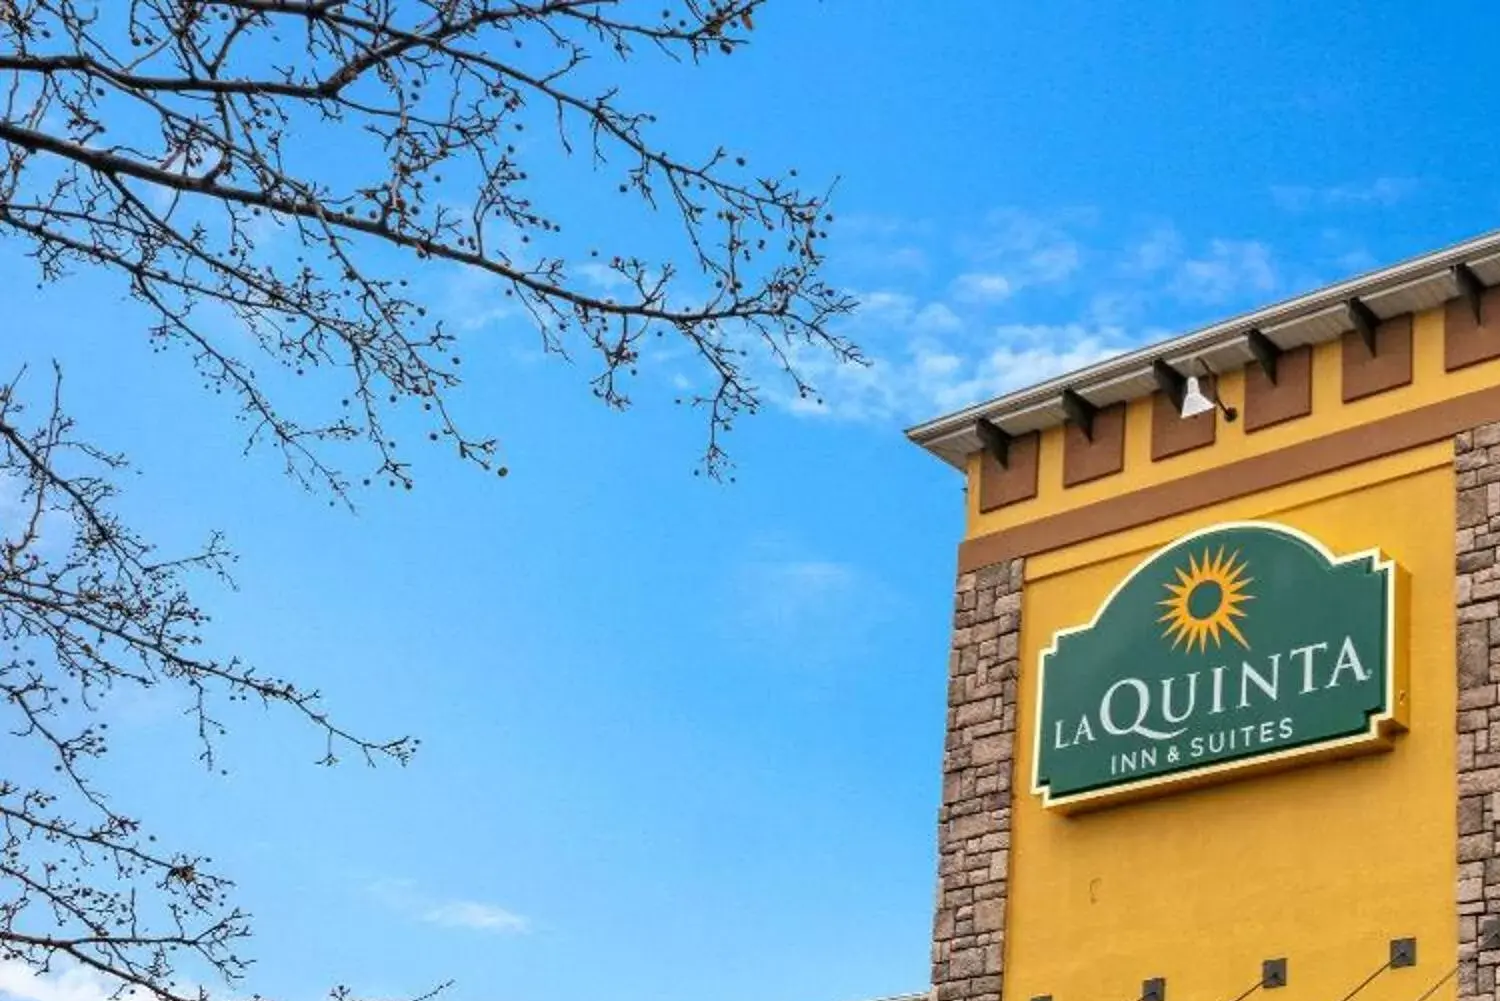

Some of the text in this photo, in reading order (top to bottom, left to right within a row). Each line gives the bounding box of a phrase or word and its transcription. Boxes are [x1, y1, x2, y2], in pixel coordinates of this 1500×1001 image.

[1055, 635, 1370, 750] LA QUINTA
[1111, 716, 1294, 775] INN & SUITES
